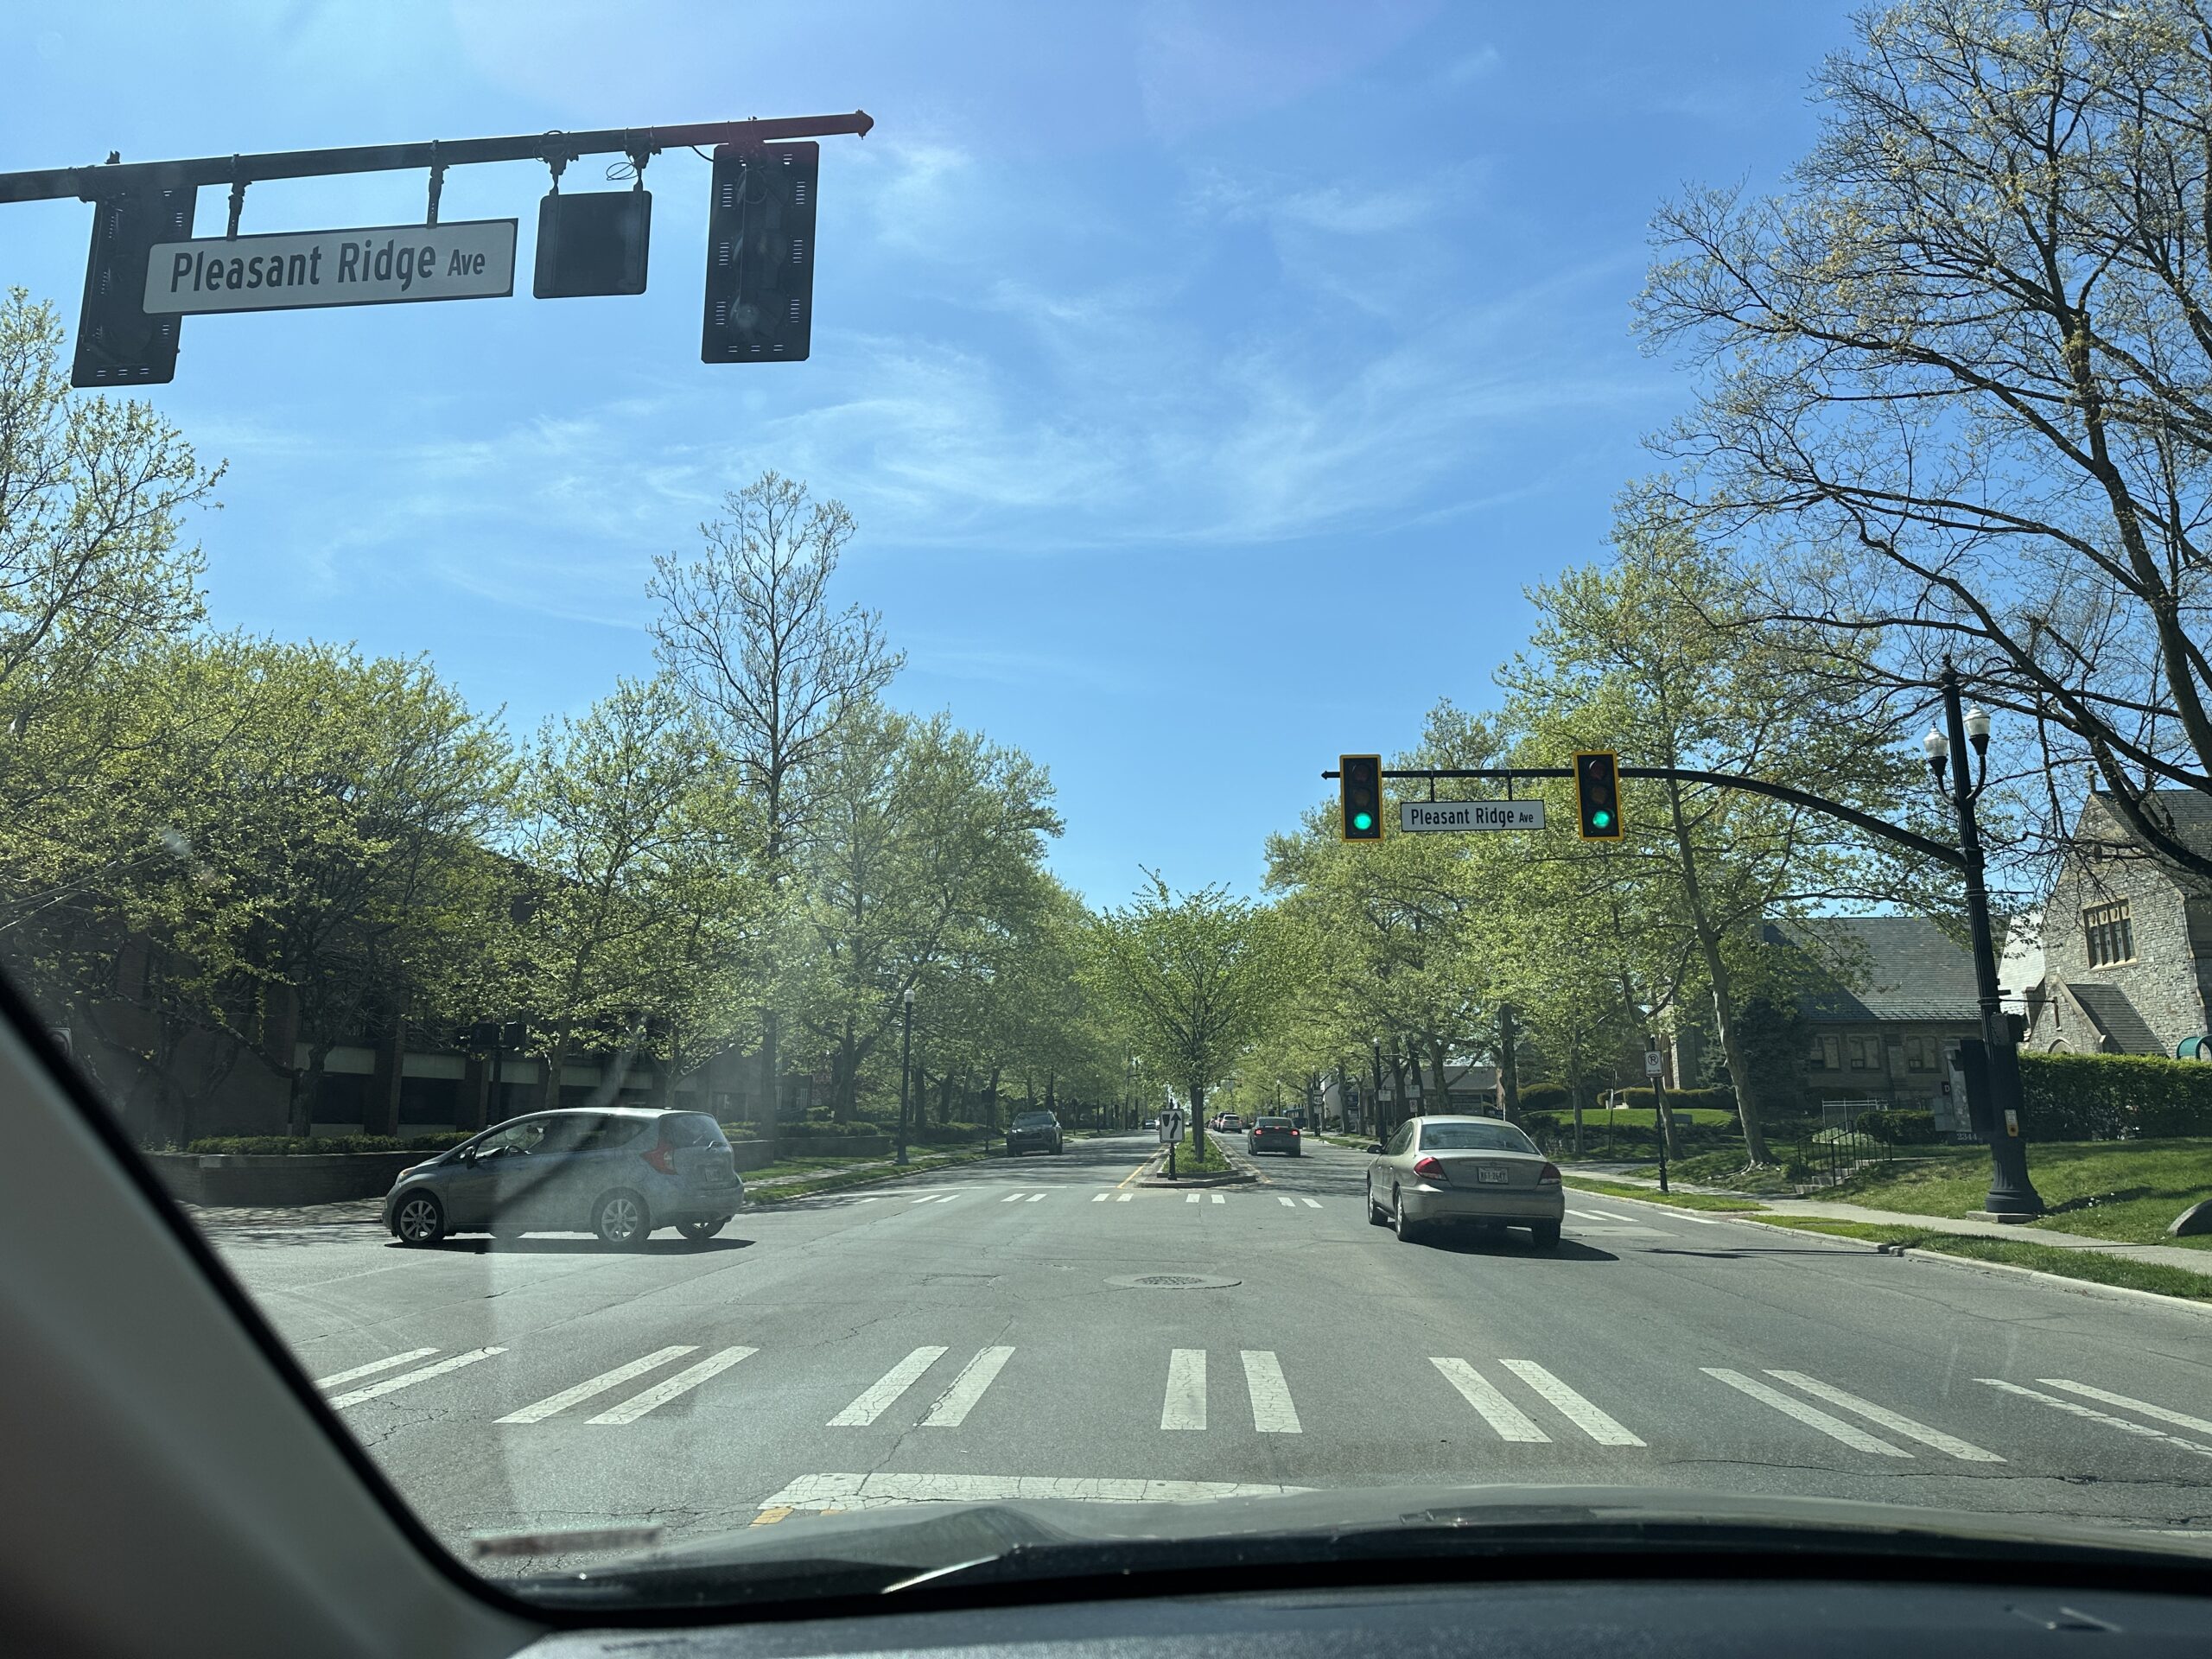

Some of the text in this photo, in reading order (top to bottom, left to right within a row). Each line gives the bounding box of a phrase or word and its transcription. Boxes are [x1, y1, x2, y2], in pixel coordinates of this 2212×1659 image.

[170, 239, 486, 293] Pleasant Ridge Ave
[1411, 807, 1534, 828] Pleasant Ridge Ave
